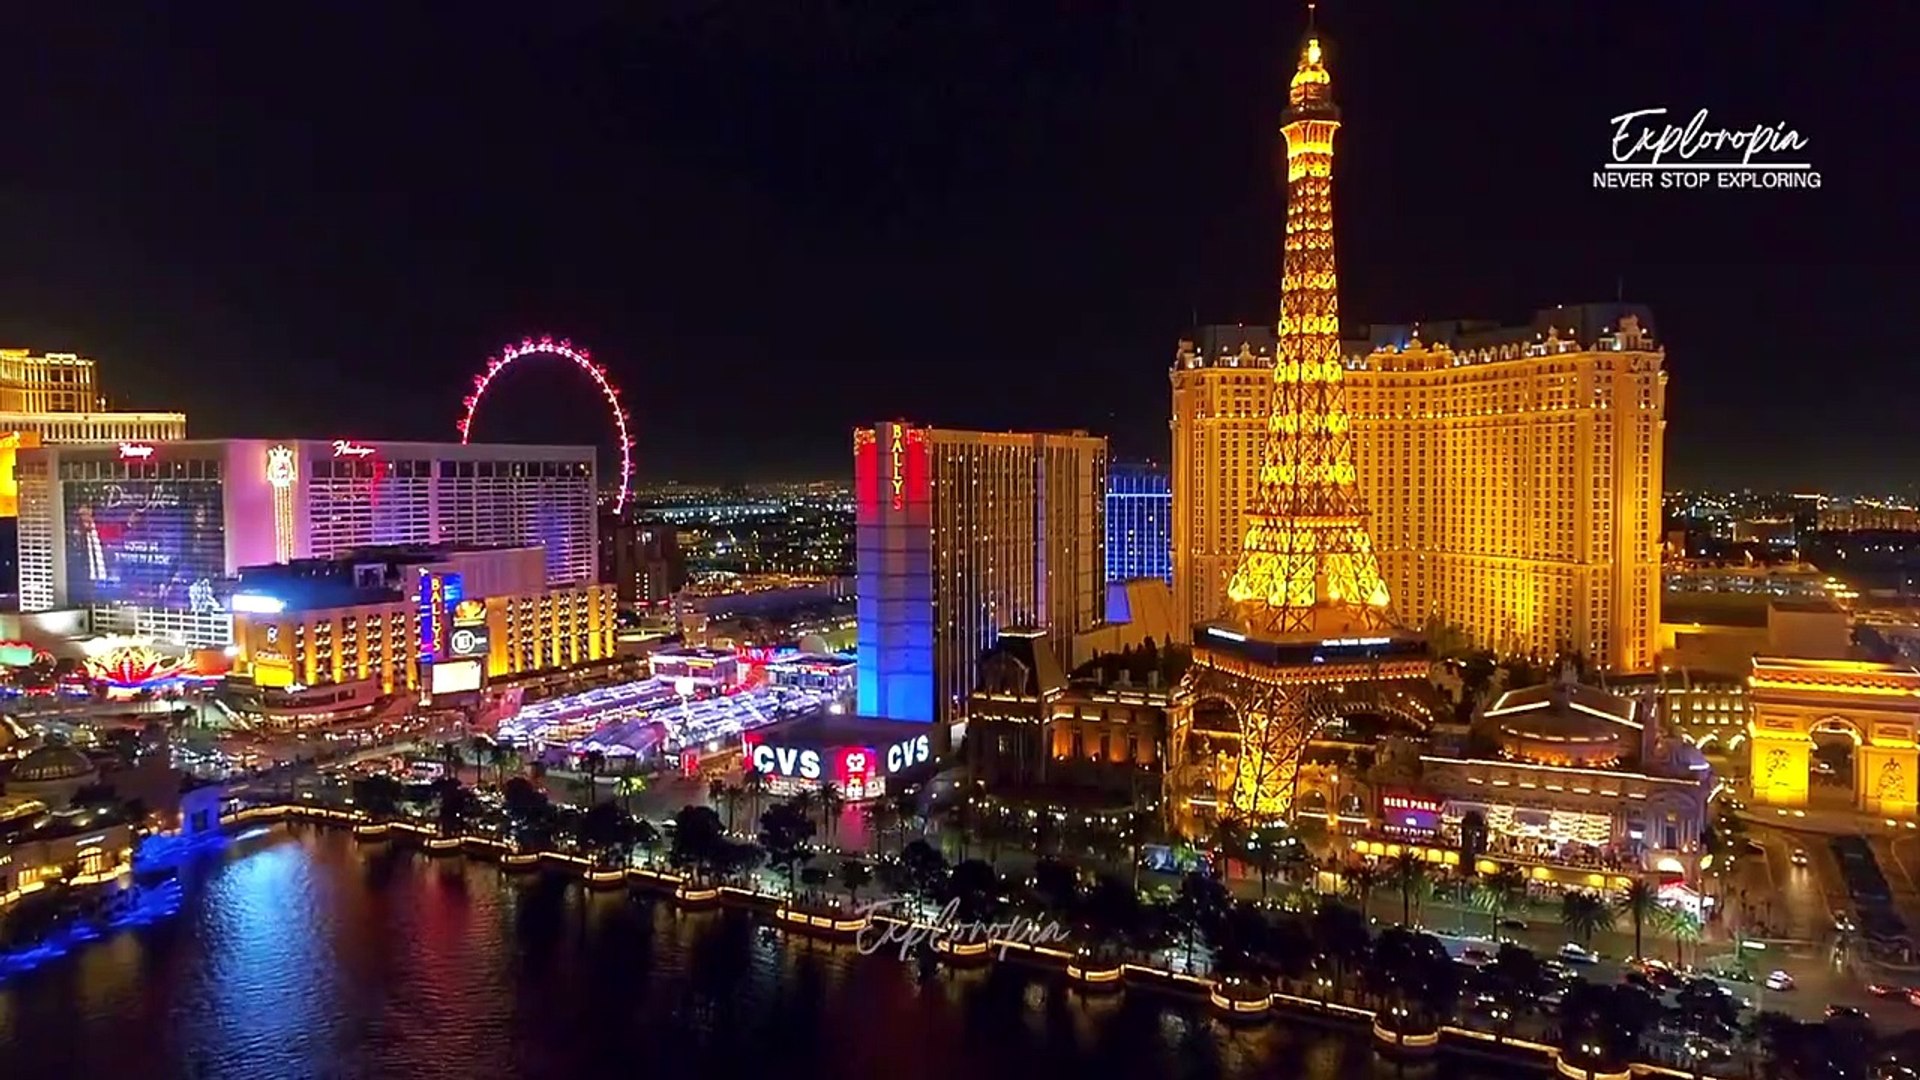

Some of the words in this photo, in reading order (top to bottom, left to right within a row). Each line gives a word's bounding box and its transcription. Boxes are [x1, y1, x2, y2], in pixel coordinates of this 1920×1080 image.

[753, 745, 821, 779] CVS
[887, 734, 929, 772] CVS
[1410, 799, 1437, 811] PARK
